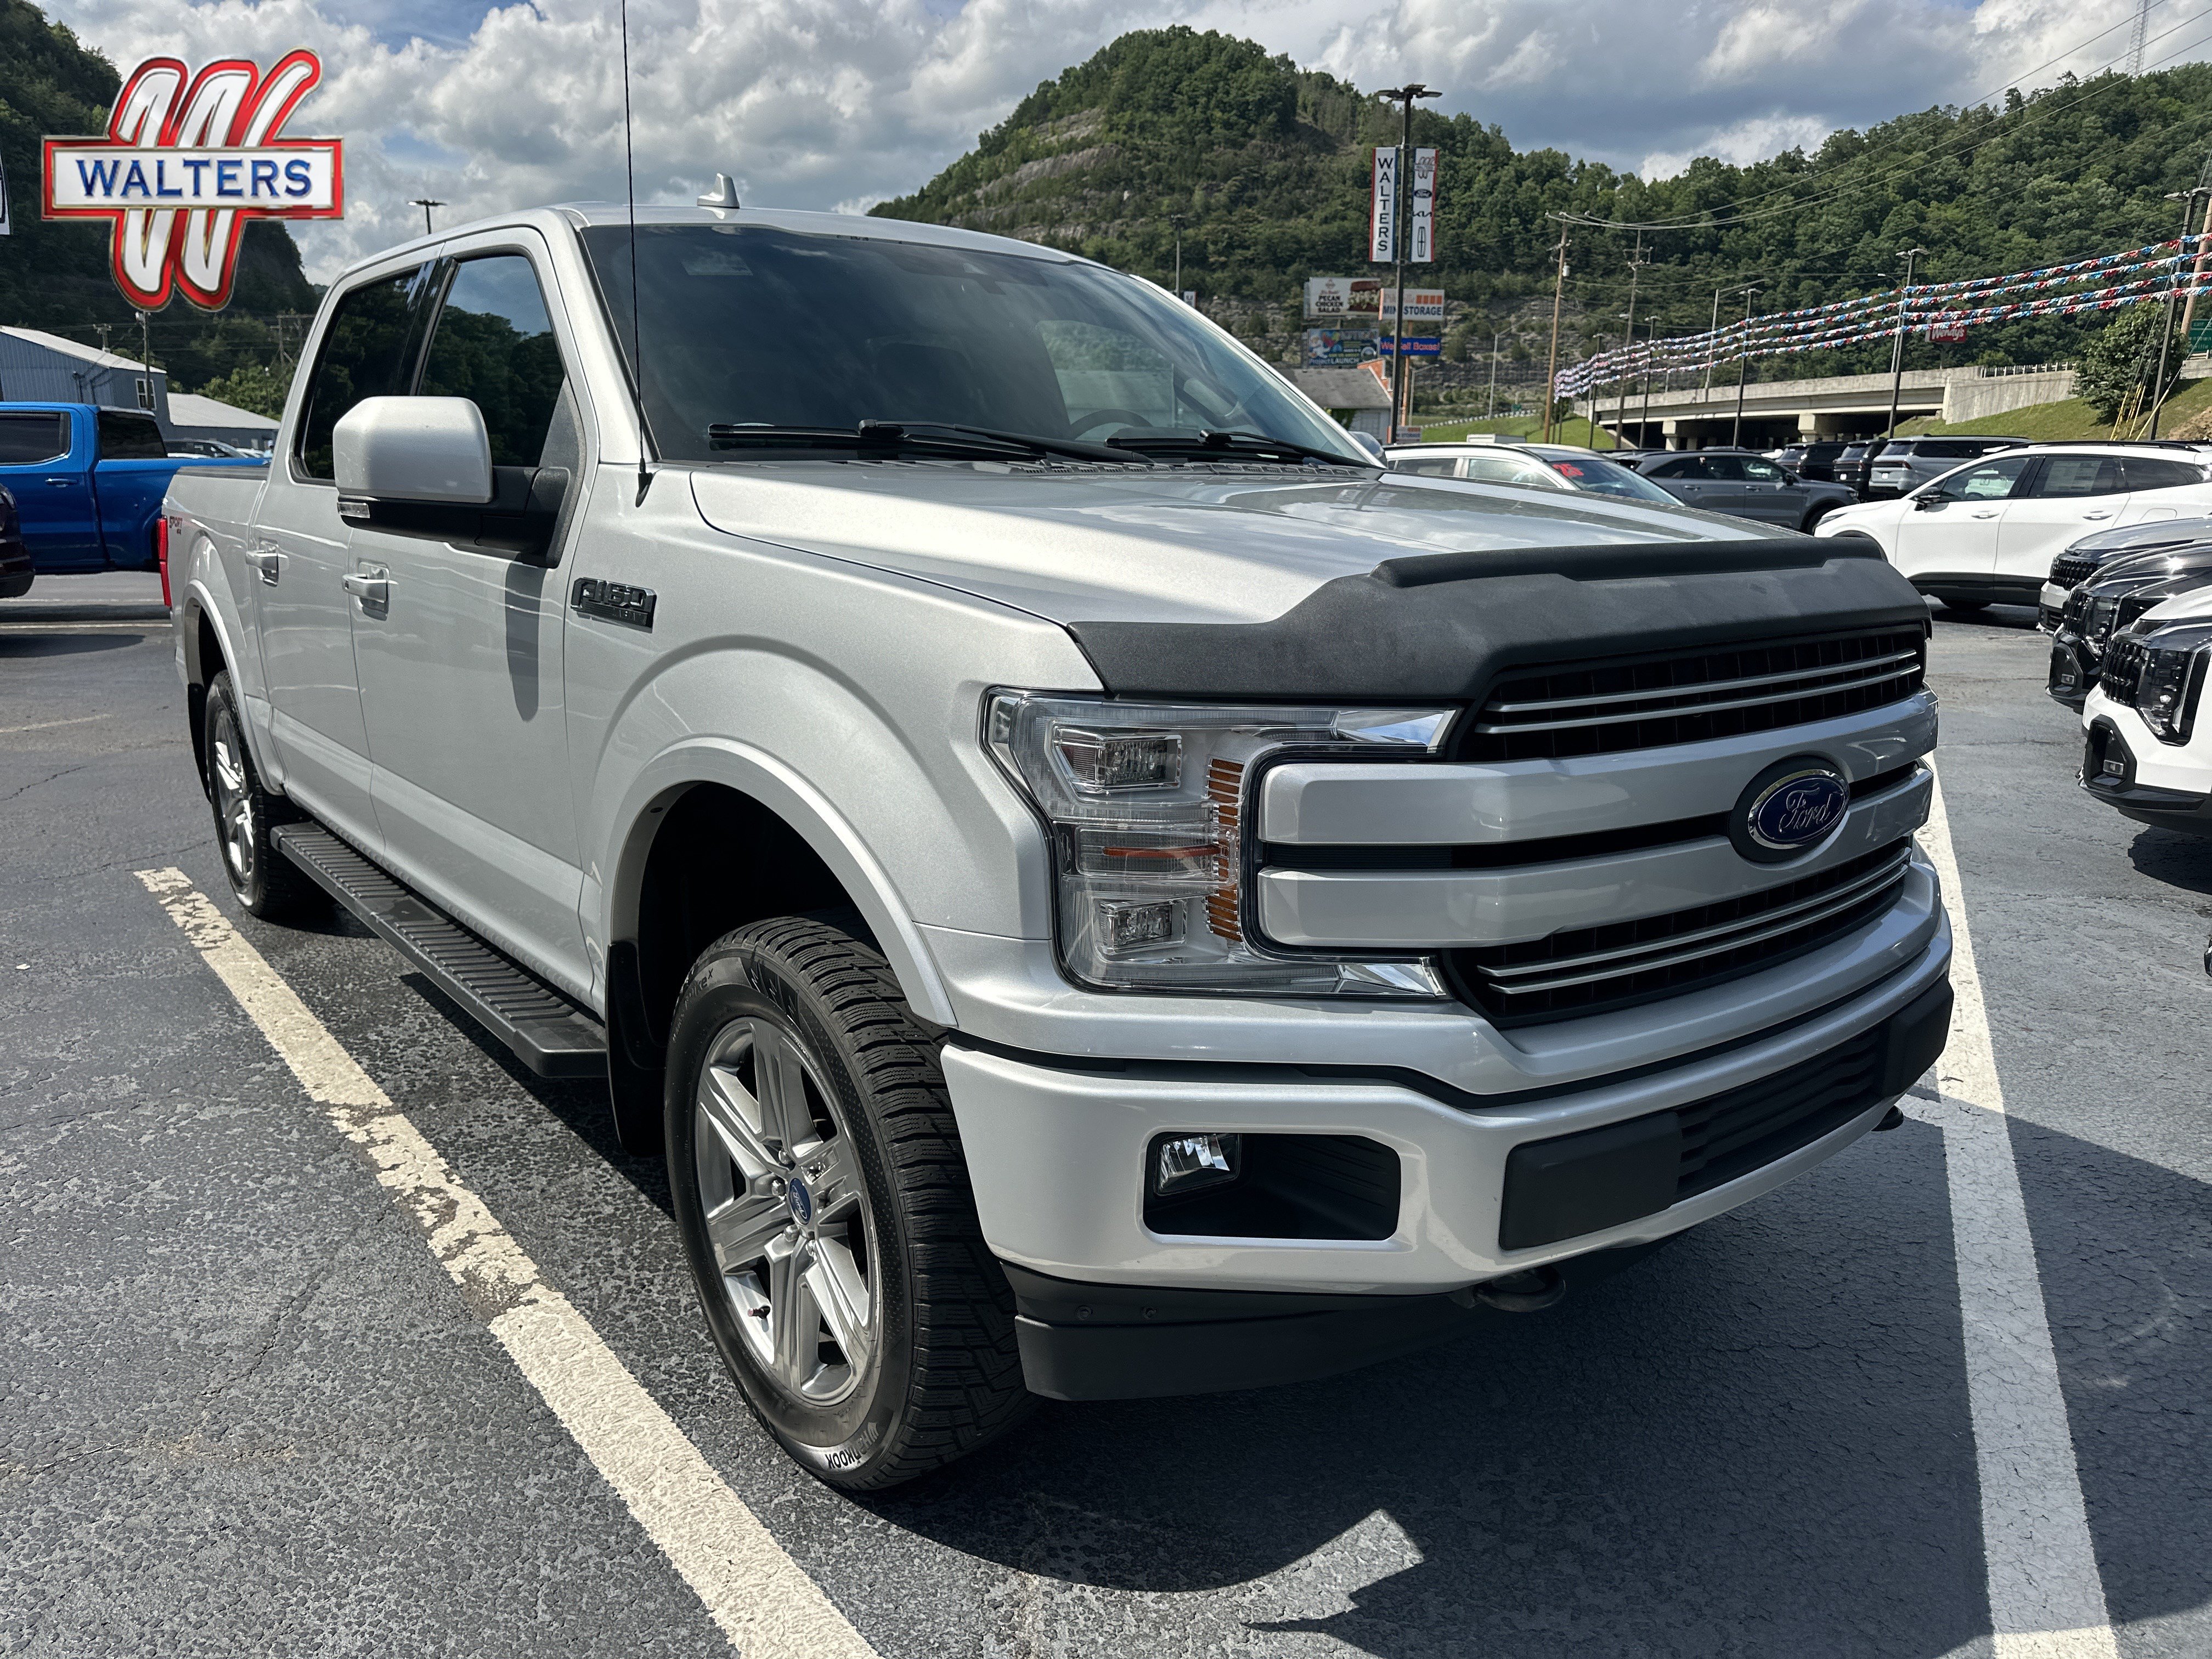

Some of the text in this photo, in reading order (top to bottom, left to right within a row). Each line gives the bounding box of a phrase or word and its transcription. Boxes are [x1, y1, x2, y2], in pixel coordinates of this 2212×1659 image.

[1377, 157, 1393, 251] WALTERS
[1383, 306, 1442, 315] MIN STORAGE
[1932, 327, 1965, 341] Wendy's
[1778, 787, 1833, 833] Ford
